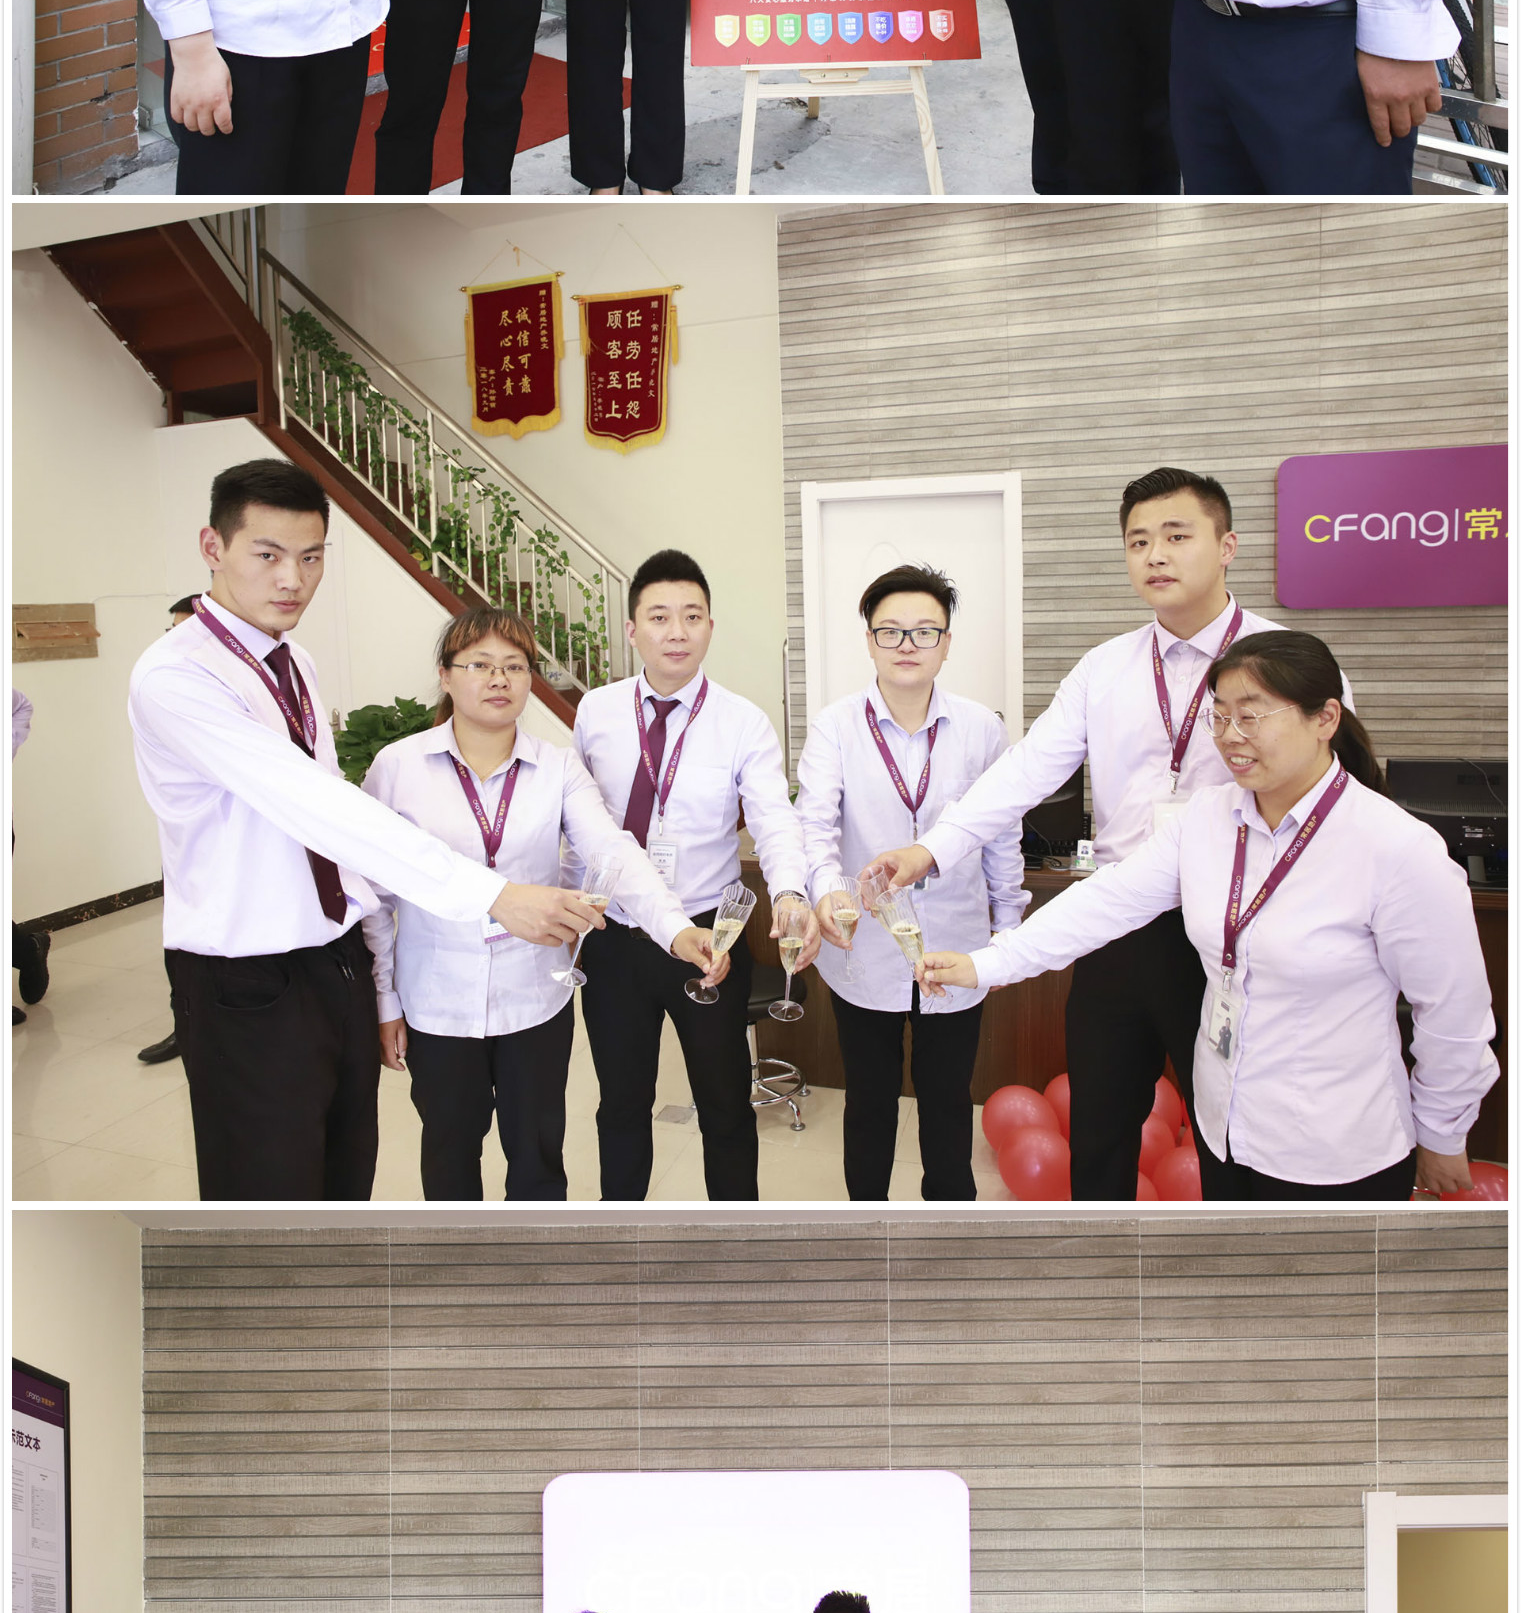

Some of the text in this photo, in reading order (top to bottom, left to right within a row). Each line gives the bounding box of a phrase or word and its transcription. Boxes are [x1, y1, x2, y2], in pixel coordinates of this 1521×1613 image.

[499, 309, 514, 397] 尽心尽责
[515, 306, 532, 394] 诚信可靠
[606, 310, 623, 420] 顾客至上
[625, 309, 643, 420] 任劳任怨
[1464, 507, 1508, 541] 常
